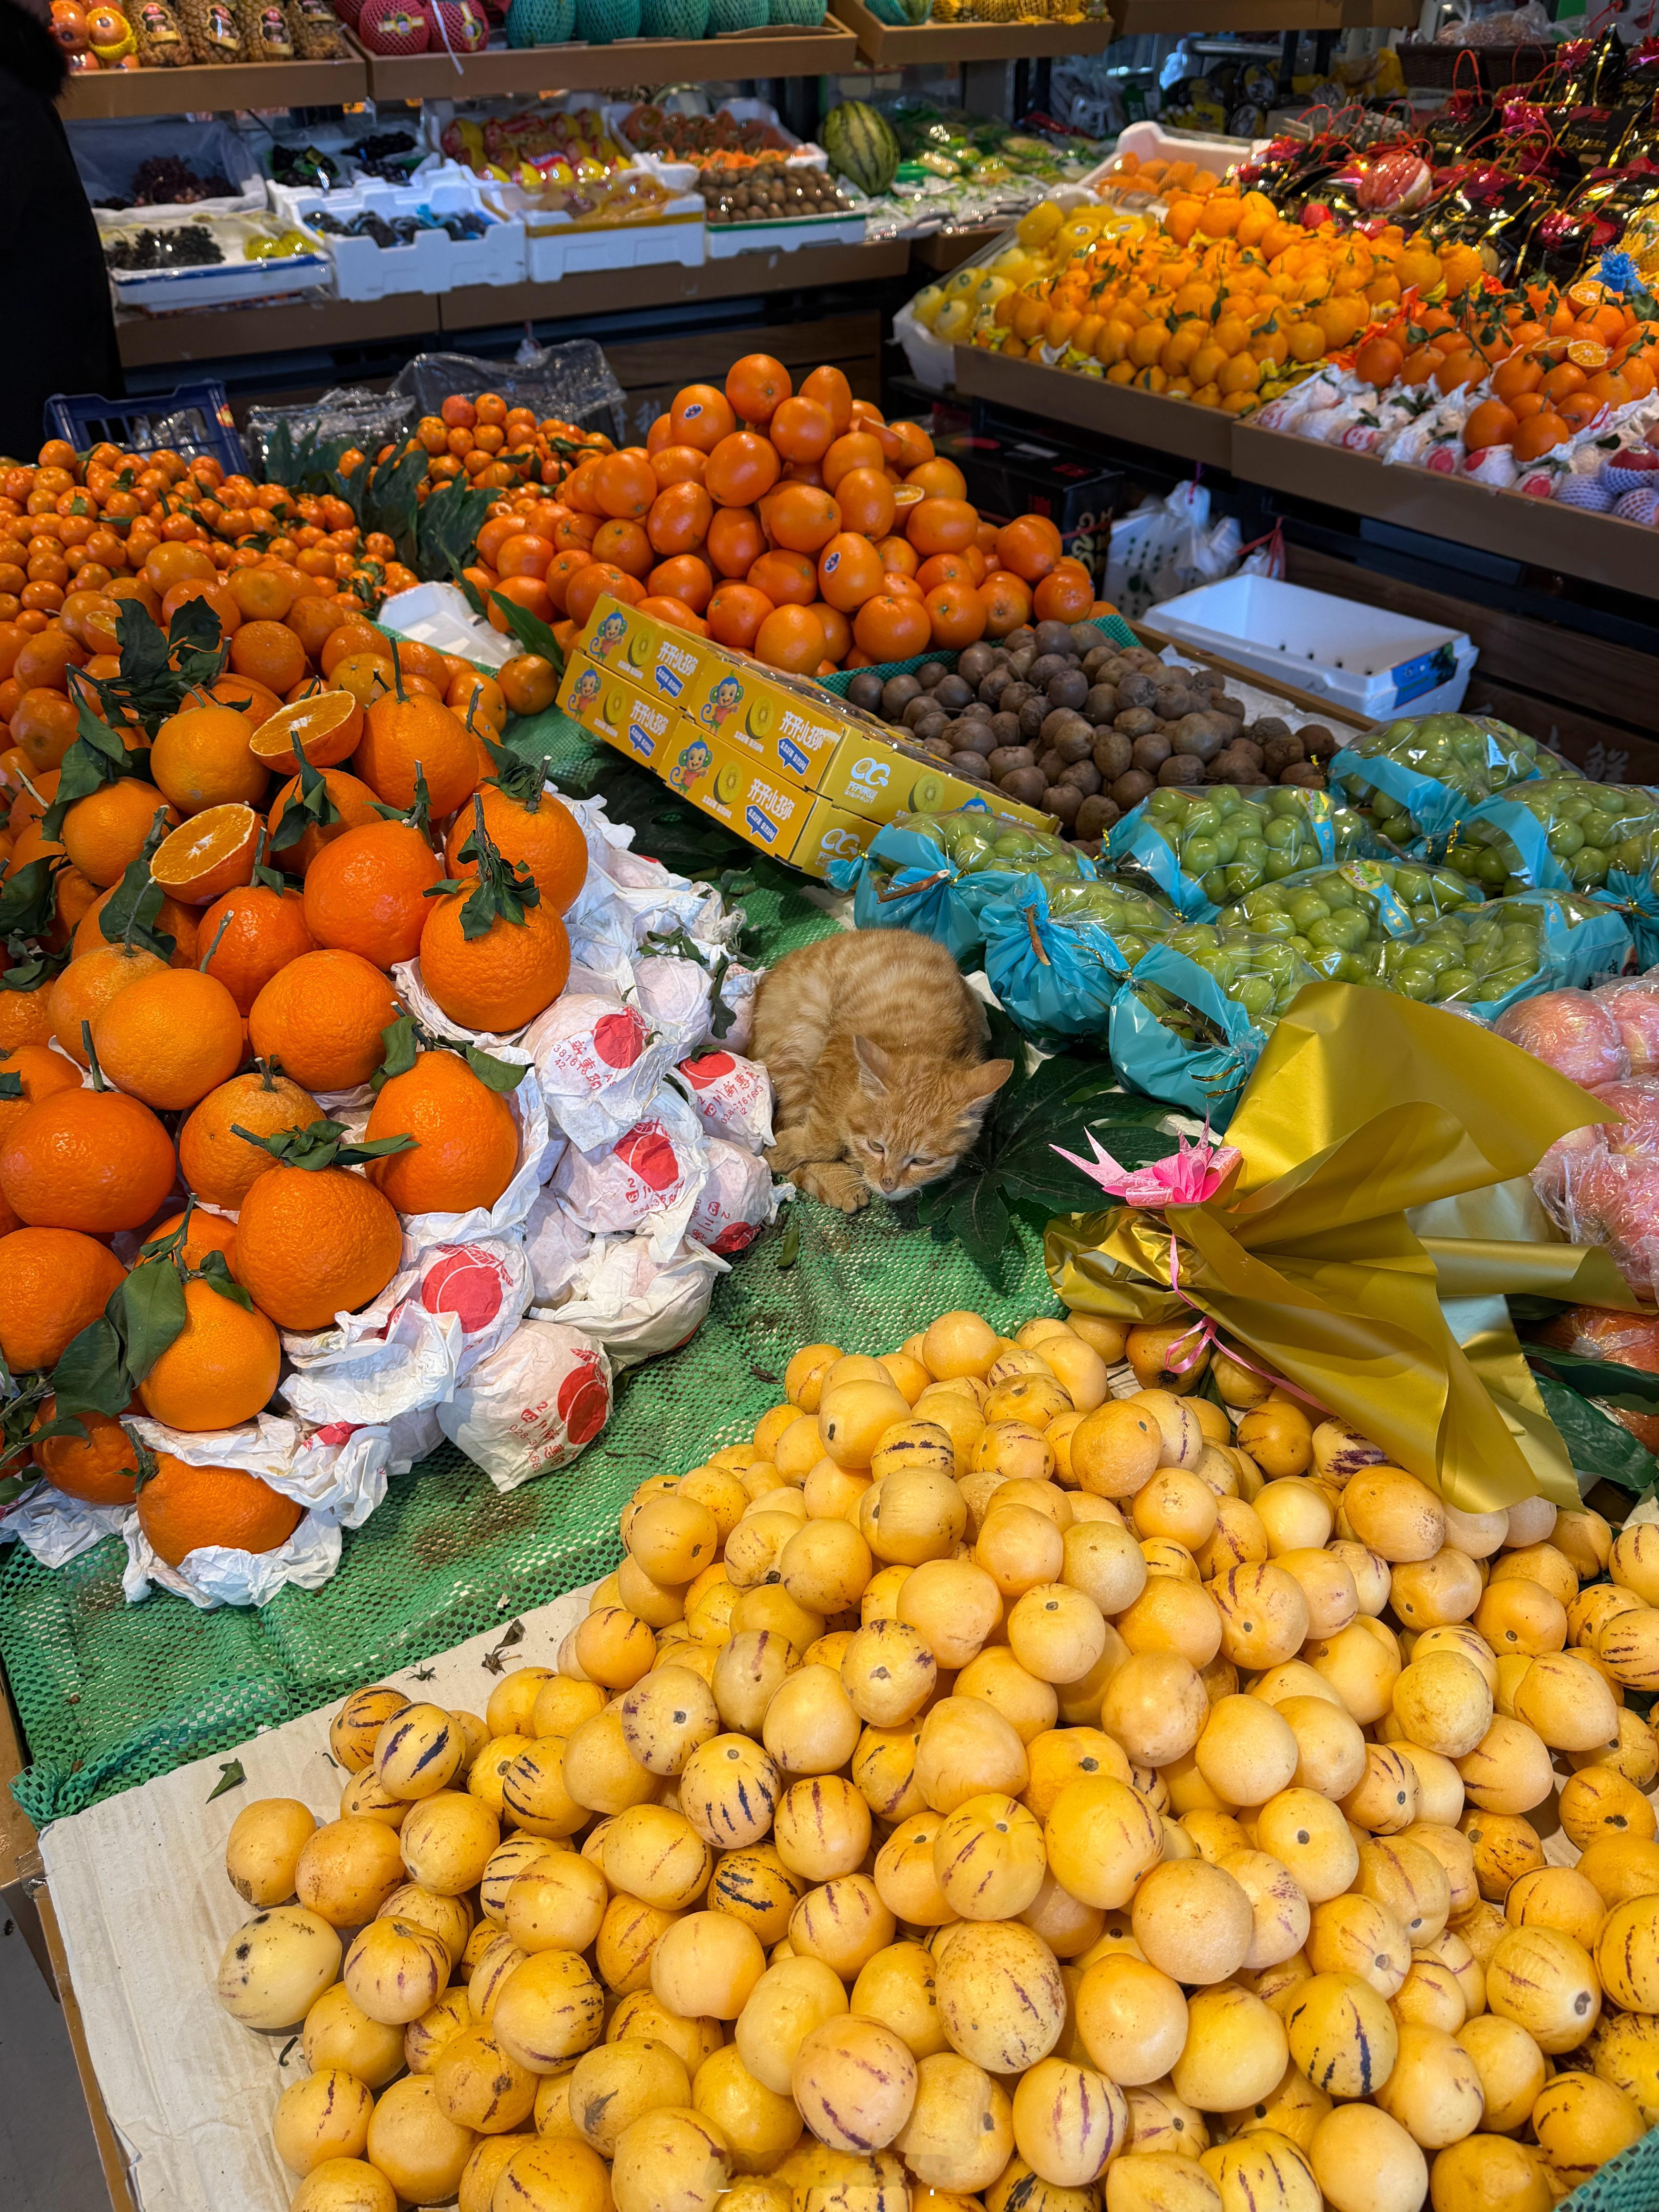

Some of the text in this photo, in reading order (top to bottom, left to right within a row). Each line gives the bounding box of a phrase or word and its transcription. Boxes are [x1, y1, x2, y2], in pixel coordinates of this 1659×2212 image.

[697, 1096, 706, 1105] 2
[627, 1177, 635, 1188] 2
[721, 1211, 730, 1219] 2
[536, 1401, 548, 1413] 2
